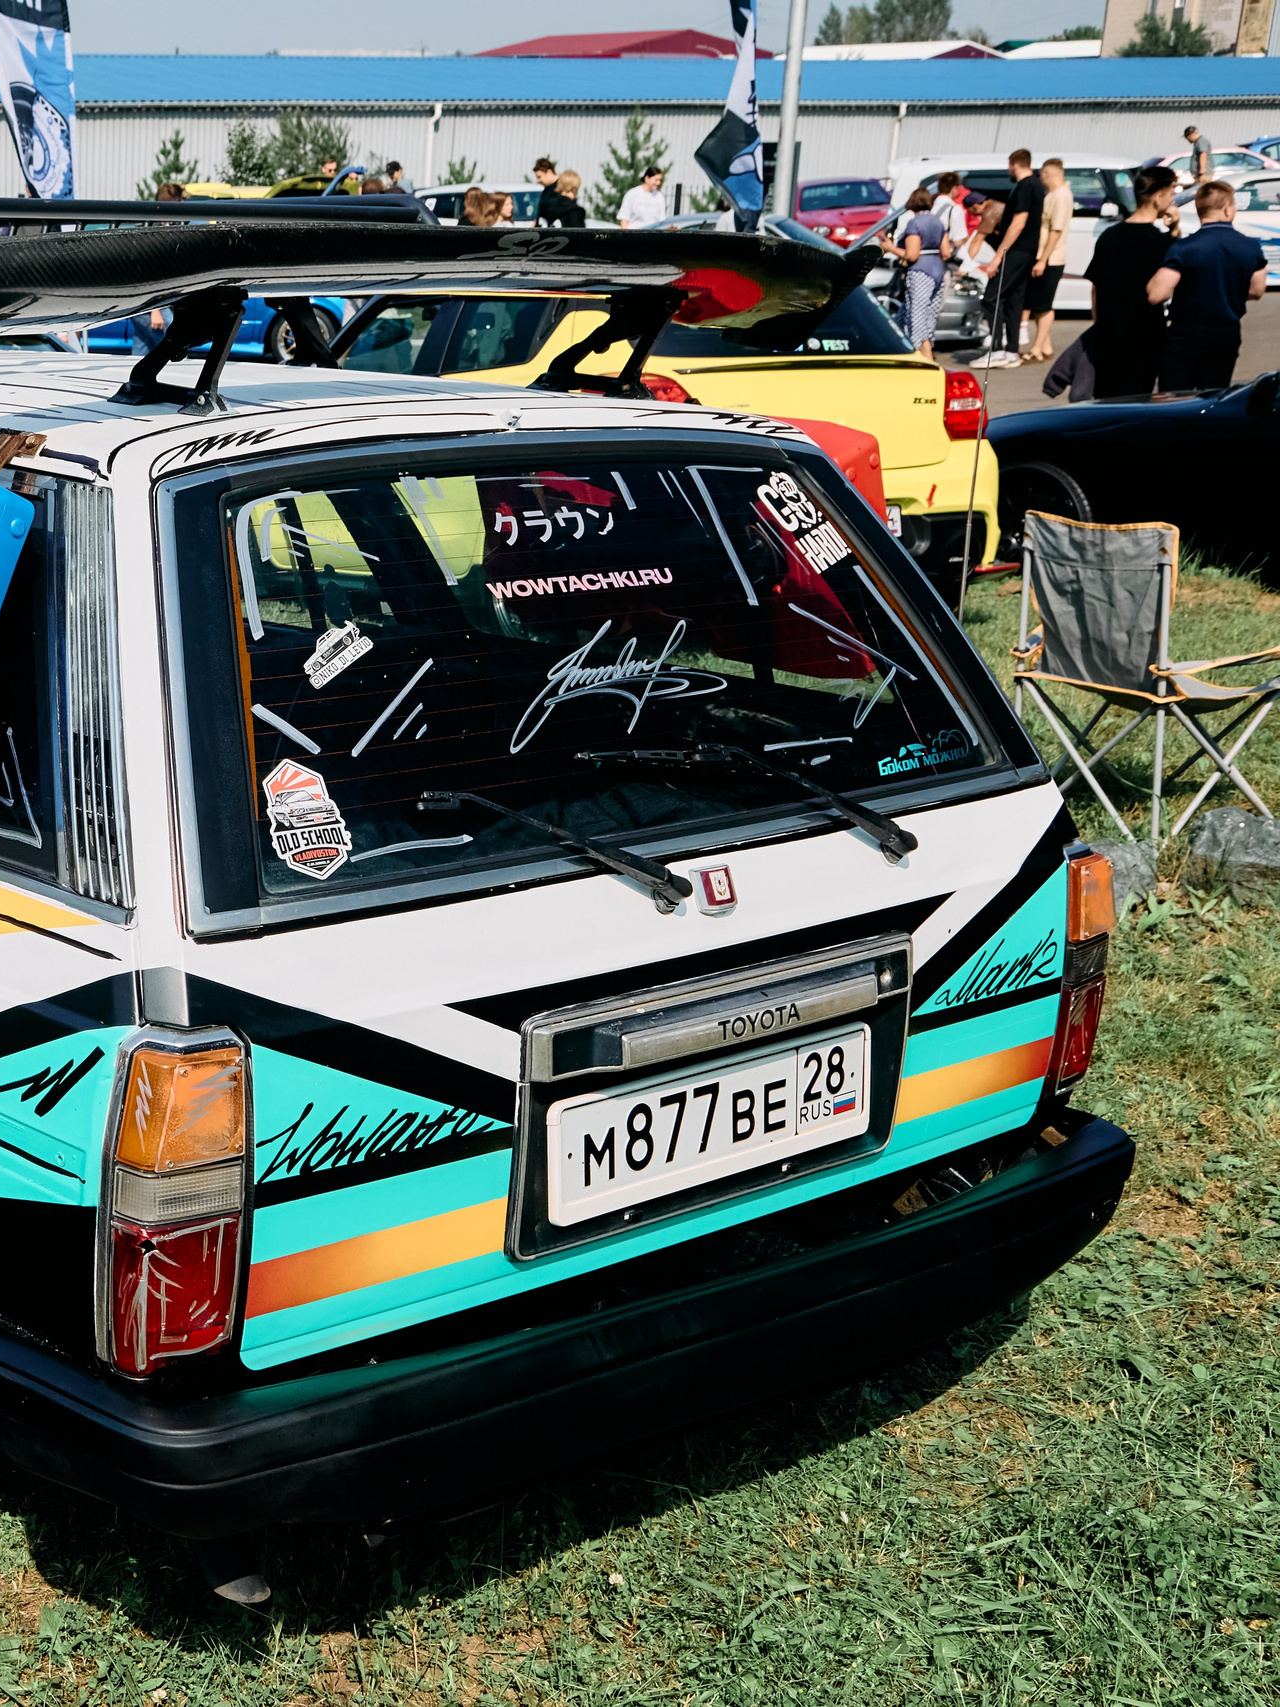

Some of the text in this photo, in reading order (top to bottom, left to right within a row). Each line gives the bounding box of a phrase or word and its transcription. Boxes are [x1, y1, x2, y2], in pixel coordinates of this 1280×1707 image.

[821, 339, 850, 352] FEST
[494, 505, 614, 546] クラウン
[794, 520, 852, 575] HARD!
[485, 567, 674, 600] WOWTACHKI.RU
[276, 826, 348, 855] OLD SCHOOL
[294, 848, 339, 862] VLADIVOSTOK
[717, 1002, 801, 1042] TOYOTA
[802, 1045, 846, 1104] 28
[799, 1099, 832, 1125] RUS
